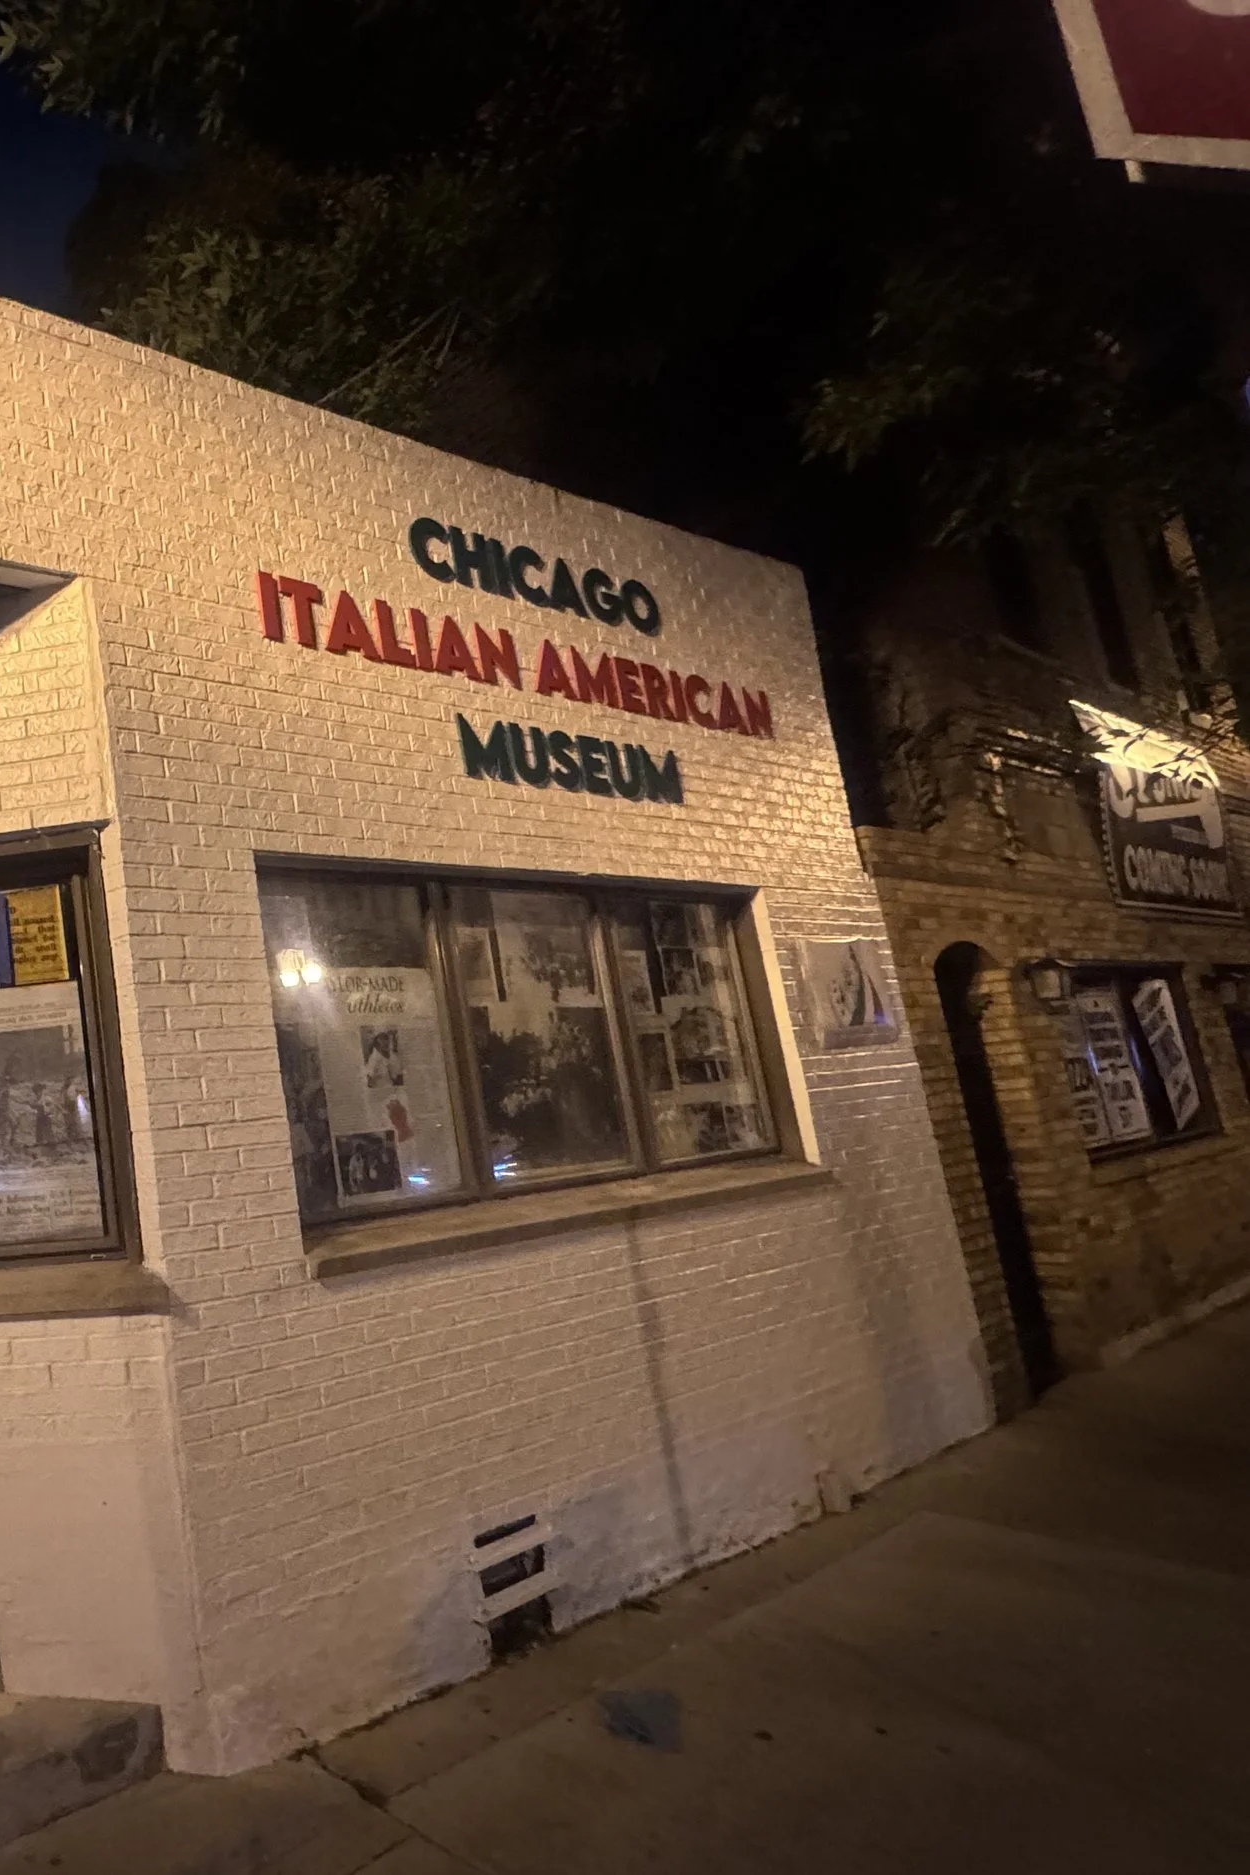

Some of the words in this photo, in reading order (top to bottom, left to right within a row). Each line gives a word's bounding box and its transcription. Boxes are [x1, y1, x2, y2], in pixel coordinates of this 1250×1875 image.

[409, 516, 661, 637] CHICAGO
[256, 570, 523, 691] ITALIAN
[534, 638, 774, 739] AMERICAN
[456, 712, 685, 805] MUSEUM
